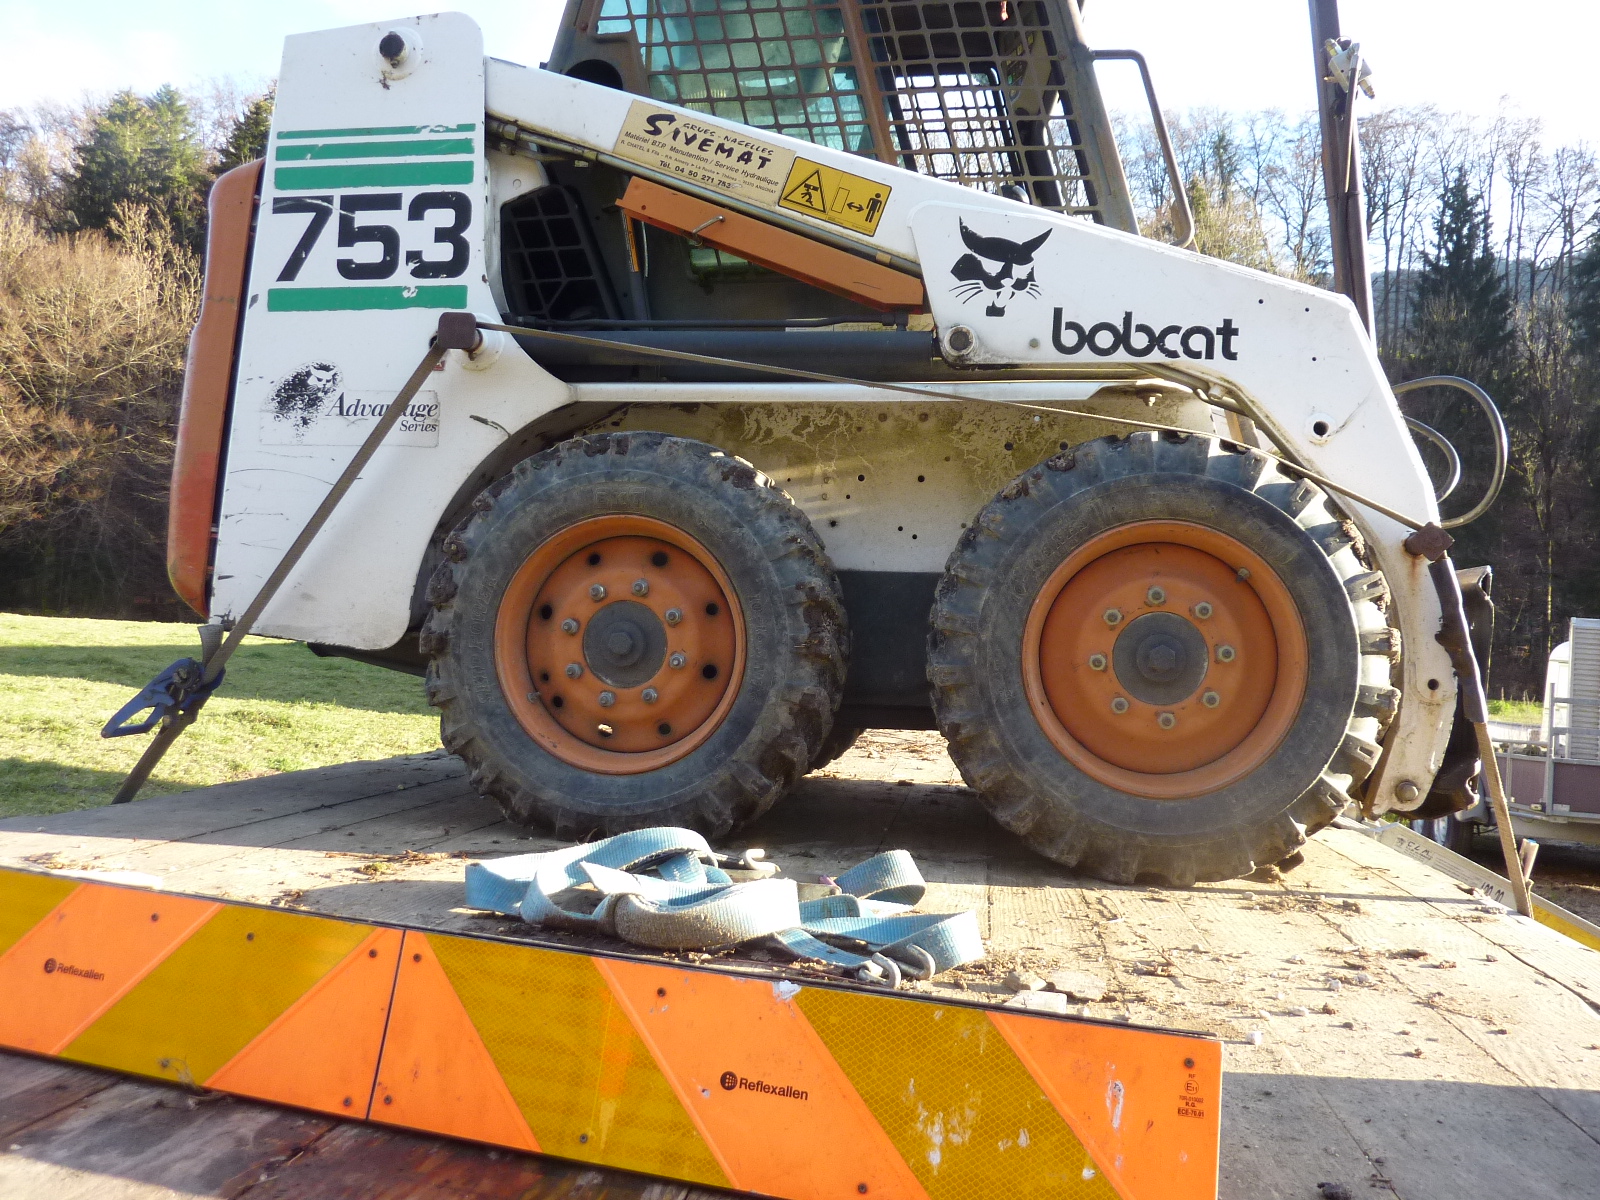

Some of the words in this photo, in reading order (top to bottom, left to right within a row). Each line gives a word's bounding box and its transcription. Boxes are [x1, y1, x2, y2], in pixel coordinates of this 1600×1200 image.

[643, 113, 771, 169] SIVEMAT
[683, 123, 716, 137] GRUES
[723, 135, 774, 156] NACELLES
[624, 131, 651, 144] Matériel
[669, 145, 709, 163] Manutention
[714, 160, 740, 173] Service
[741, 169, 779, 186] Hydraulique
[675, 165, 685, 173] 04
[701, 174, 715, 183] 271
[272, 191, 472, 282] 753
[1051, 306, 1239, 361] bobcat
[325, 391, 438, 422] Advaage
[399, 420, 438, 432] Series
[57, 962, 105, 981] Reflexallen
[739, 1077, 809, 1101] Reflexallen
